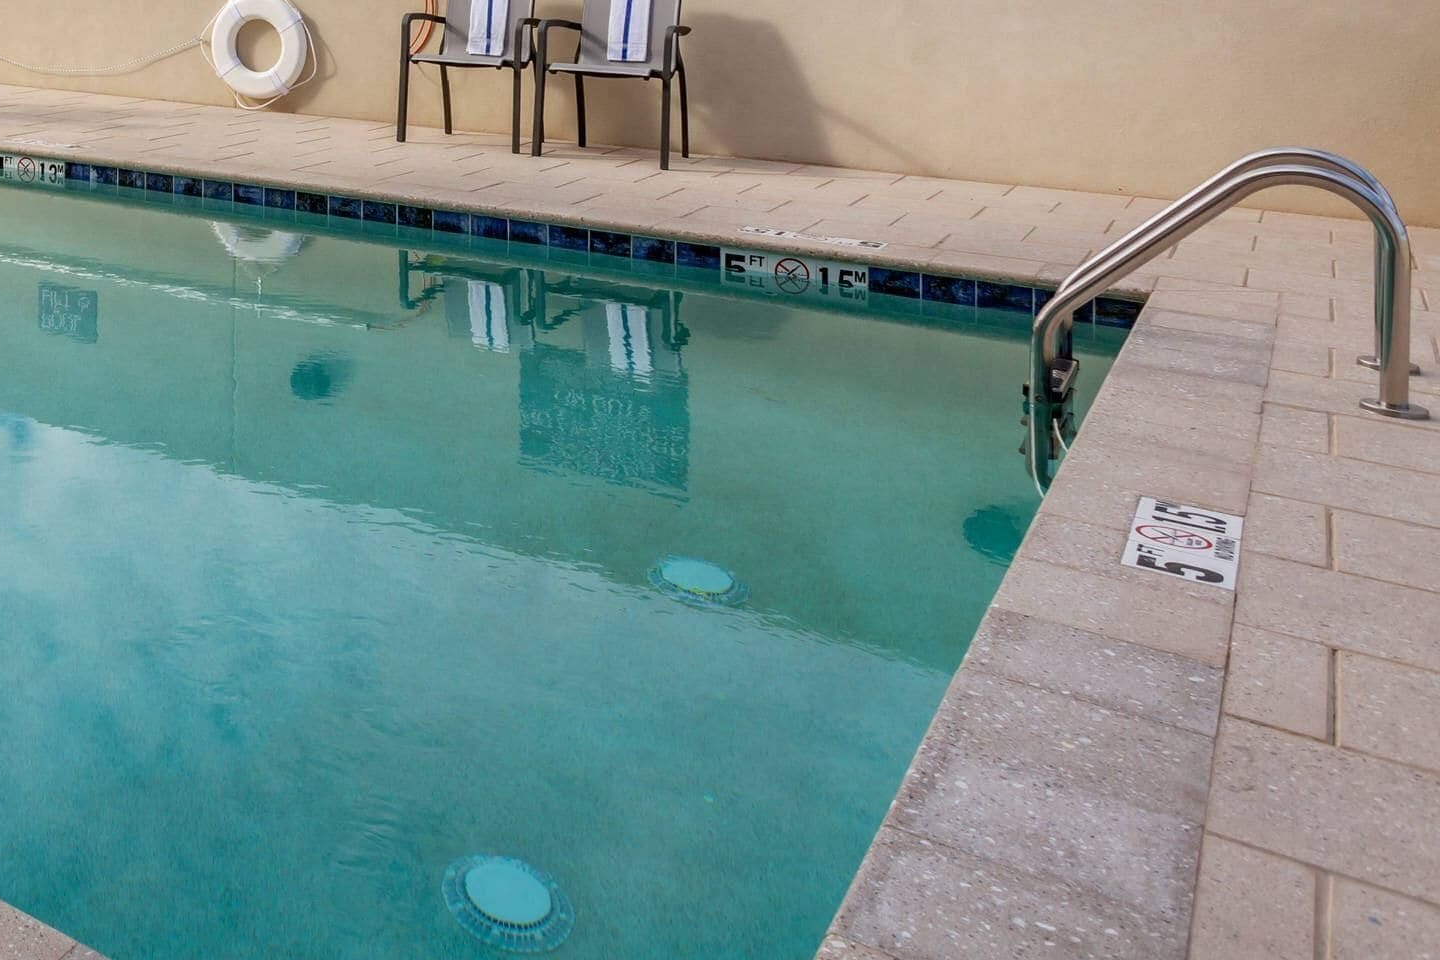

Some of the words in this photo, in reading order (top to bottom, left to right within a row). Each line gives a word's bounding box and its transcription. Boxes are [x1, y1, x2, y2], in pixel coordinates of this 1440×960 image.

[5, 156, 13, 164] FT
[725, 253, 747, 274] 5
[749, 254, 765, 268] FT
[1136, 542, 1166, 558] FT
[1136, 553, 1225, 583] 5
